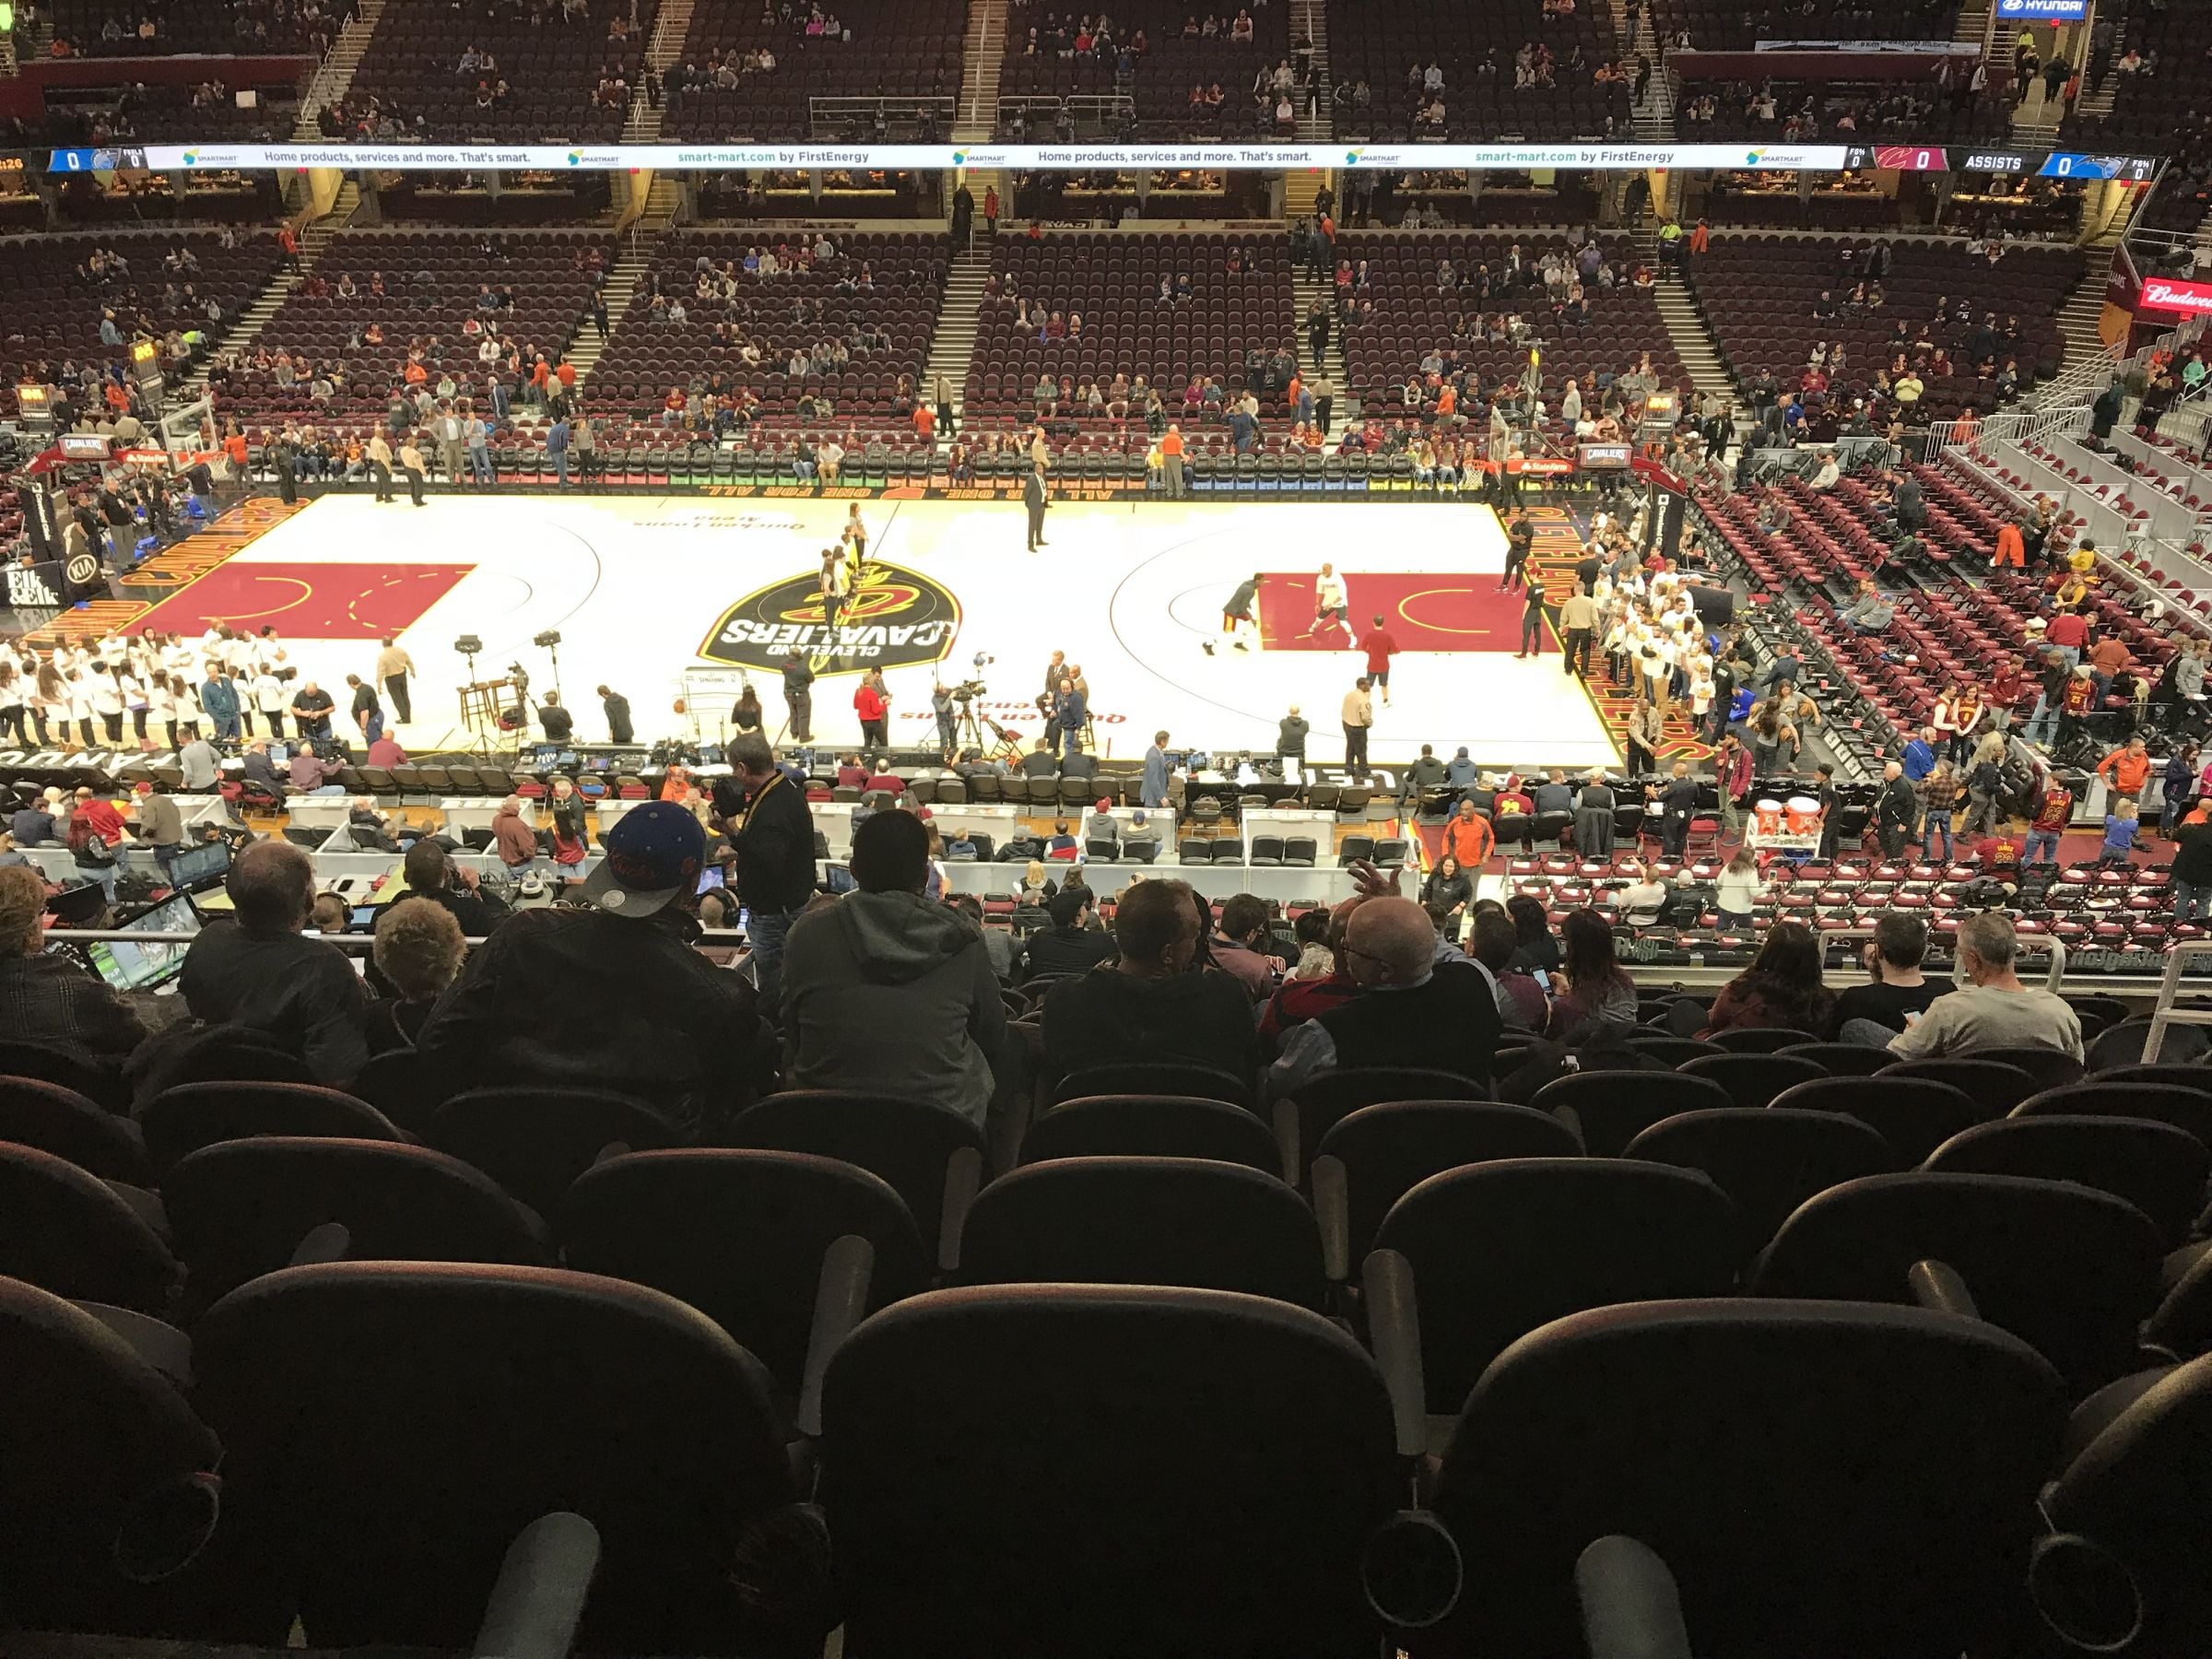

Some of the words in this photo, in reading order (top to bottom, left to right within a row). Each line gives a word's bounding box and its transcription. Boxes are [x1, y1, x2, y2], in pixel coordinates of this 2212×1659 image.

[2025, 0, 2083, 11] HYUNDAI
[66, 152, 79, 170] 0
[131, 155, 140, 168] 0
[265, 151, 297, 161] Home
[300, 151, 353, 163] products,
[356, 152, 400, 162] services
[403, 152, 423, 162] and
[426, 154, 458, 162] more.
[460, 152, 493, 162] That's
[496, 152, 531, 162] smart.
[677, 151, 776, 162] smart-mart.com
[779, 151, 794, 164] by
[798, 151, 869, 164] FirstEnergy
[1038, 151, 1072, 161] Home
[1075, 151, 1128, 163] products,
[1131, 151, 1177, 161] services
[1179, 151, 1200, 161] and
[1204, 153, 1237, 161] more.
[1240, 151, 1274, 161] That's
[1277, 152, 1312, 161] smart.
[1476, 151, 1577, 162] smart-mart.com
[1581, 150, 1597, 163] by
[1600, 150, 1675, 163] FirstEnergy
[1852, 156, 1860, 168] 0
[1916, 151, 1930, 169] 0
[1965, 155, 2022, 170] ASSISTS
[2058, 158, 2072, 175] 0
[2134, 168, 2144, 180] 0
[65, 439, 102, 451] CAVALIERS
[1586, 449, 1626, 460] CAVALIERS
[699, 486, 756, 497] ALL.
[763, 486, 815, 498] FOR
[821, 487, 872, 498] ONE
[940, 488, 995, 500] ONE.
[1065, 489, 1114, 500] ALL
[69, 560, 93, 580] KIA
[6, 570, 43, 590] Elk
[720, 618, 958, 646] CAVALIERS
